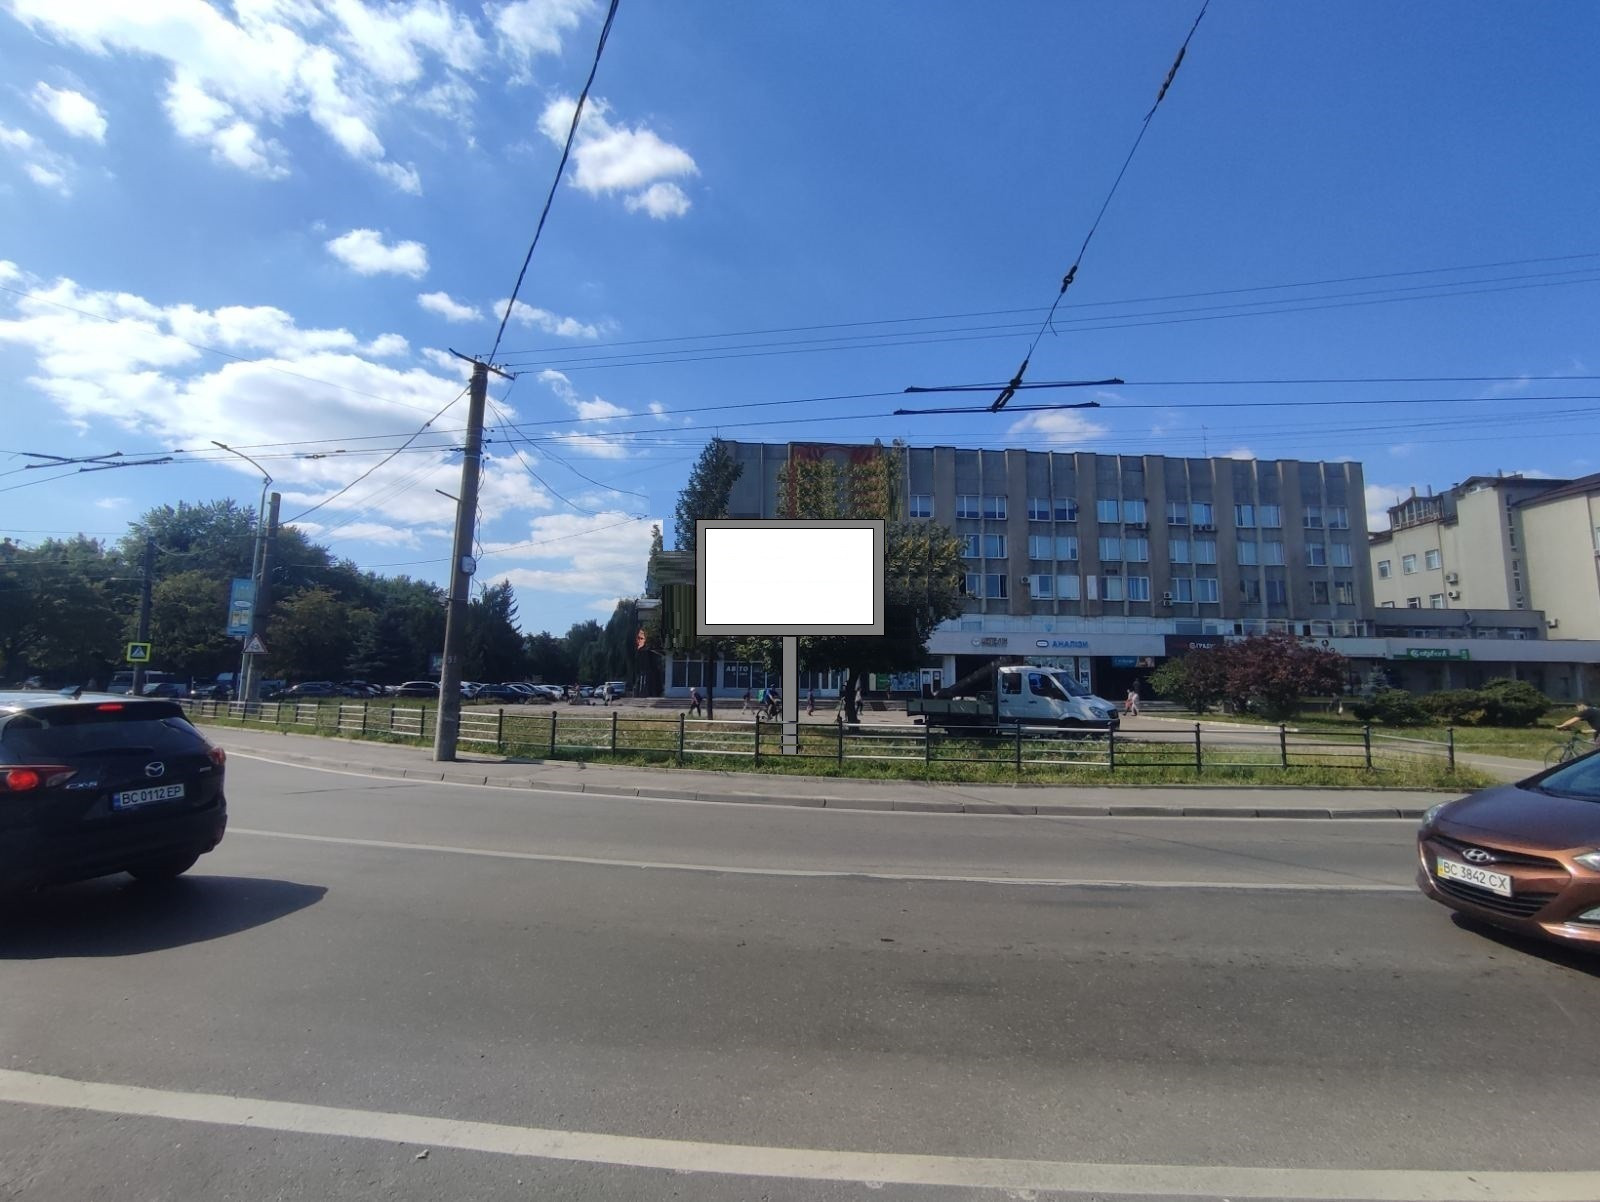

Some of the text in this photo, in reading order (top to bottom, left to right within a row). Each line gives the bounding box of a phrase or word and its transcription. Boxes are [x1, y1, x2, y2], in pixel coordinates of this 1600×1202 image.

[1052, 640, 1088, 649] АНАЛІЗИ
[141, 788, 165, 801] 0112
[1460, 865, 1486, 884] 3842
[1488, 874, 1507, 890] CX
